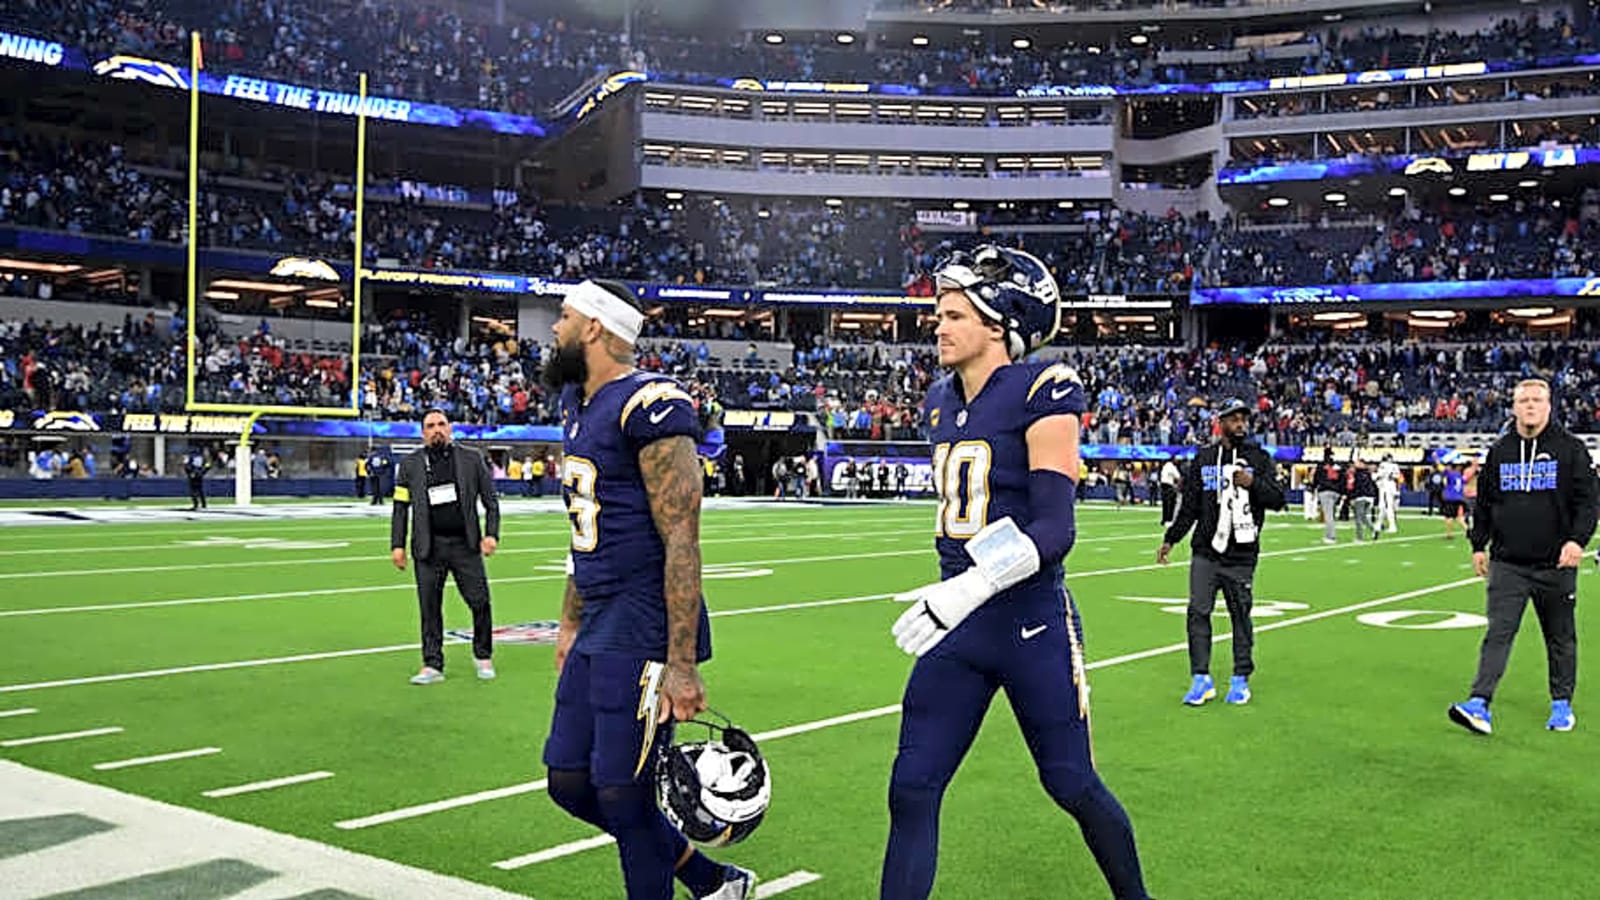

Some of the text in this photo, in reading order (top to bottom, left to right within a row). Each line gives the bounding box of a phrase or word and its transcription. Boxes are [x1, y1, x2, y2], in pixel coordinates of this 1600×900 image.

[0, 32, 63, 65] NING
[224, 75, 411, 121] FEEL THE THUNDER
[361, 268, 418, 284] PLAYOFF
[123, 414, 156, 431] FEEL
[159, 415, 187, 432] THE
[933, 440, 992, 539] 10
